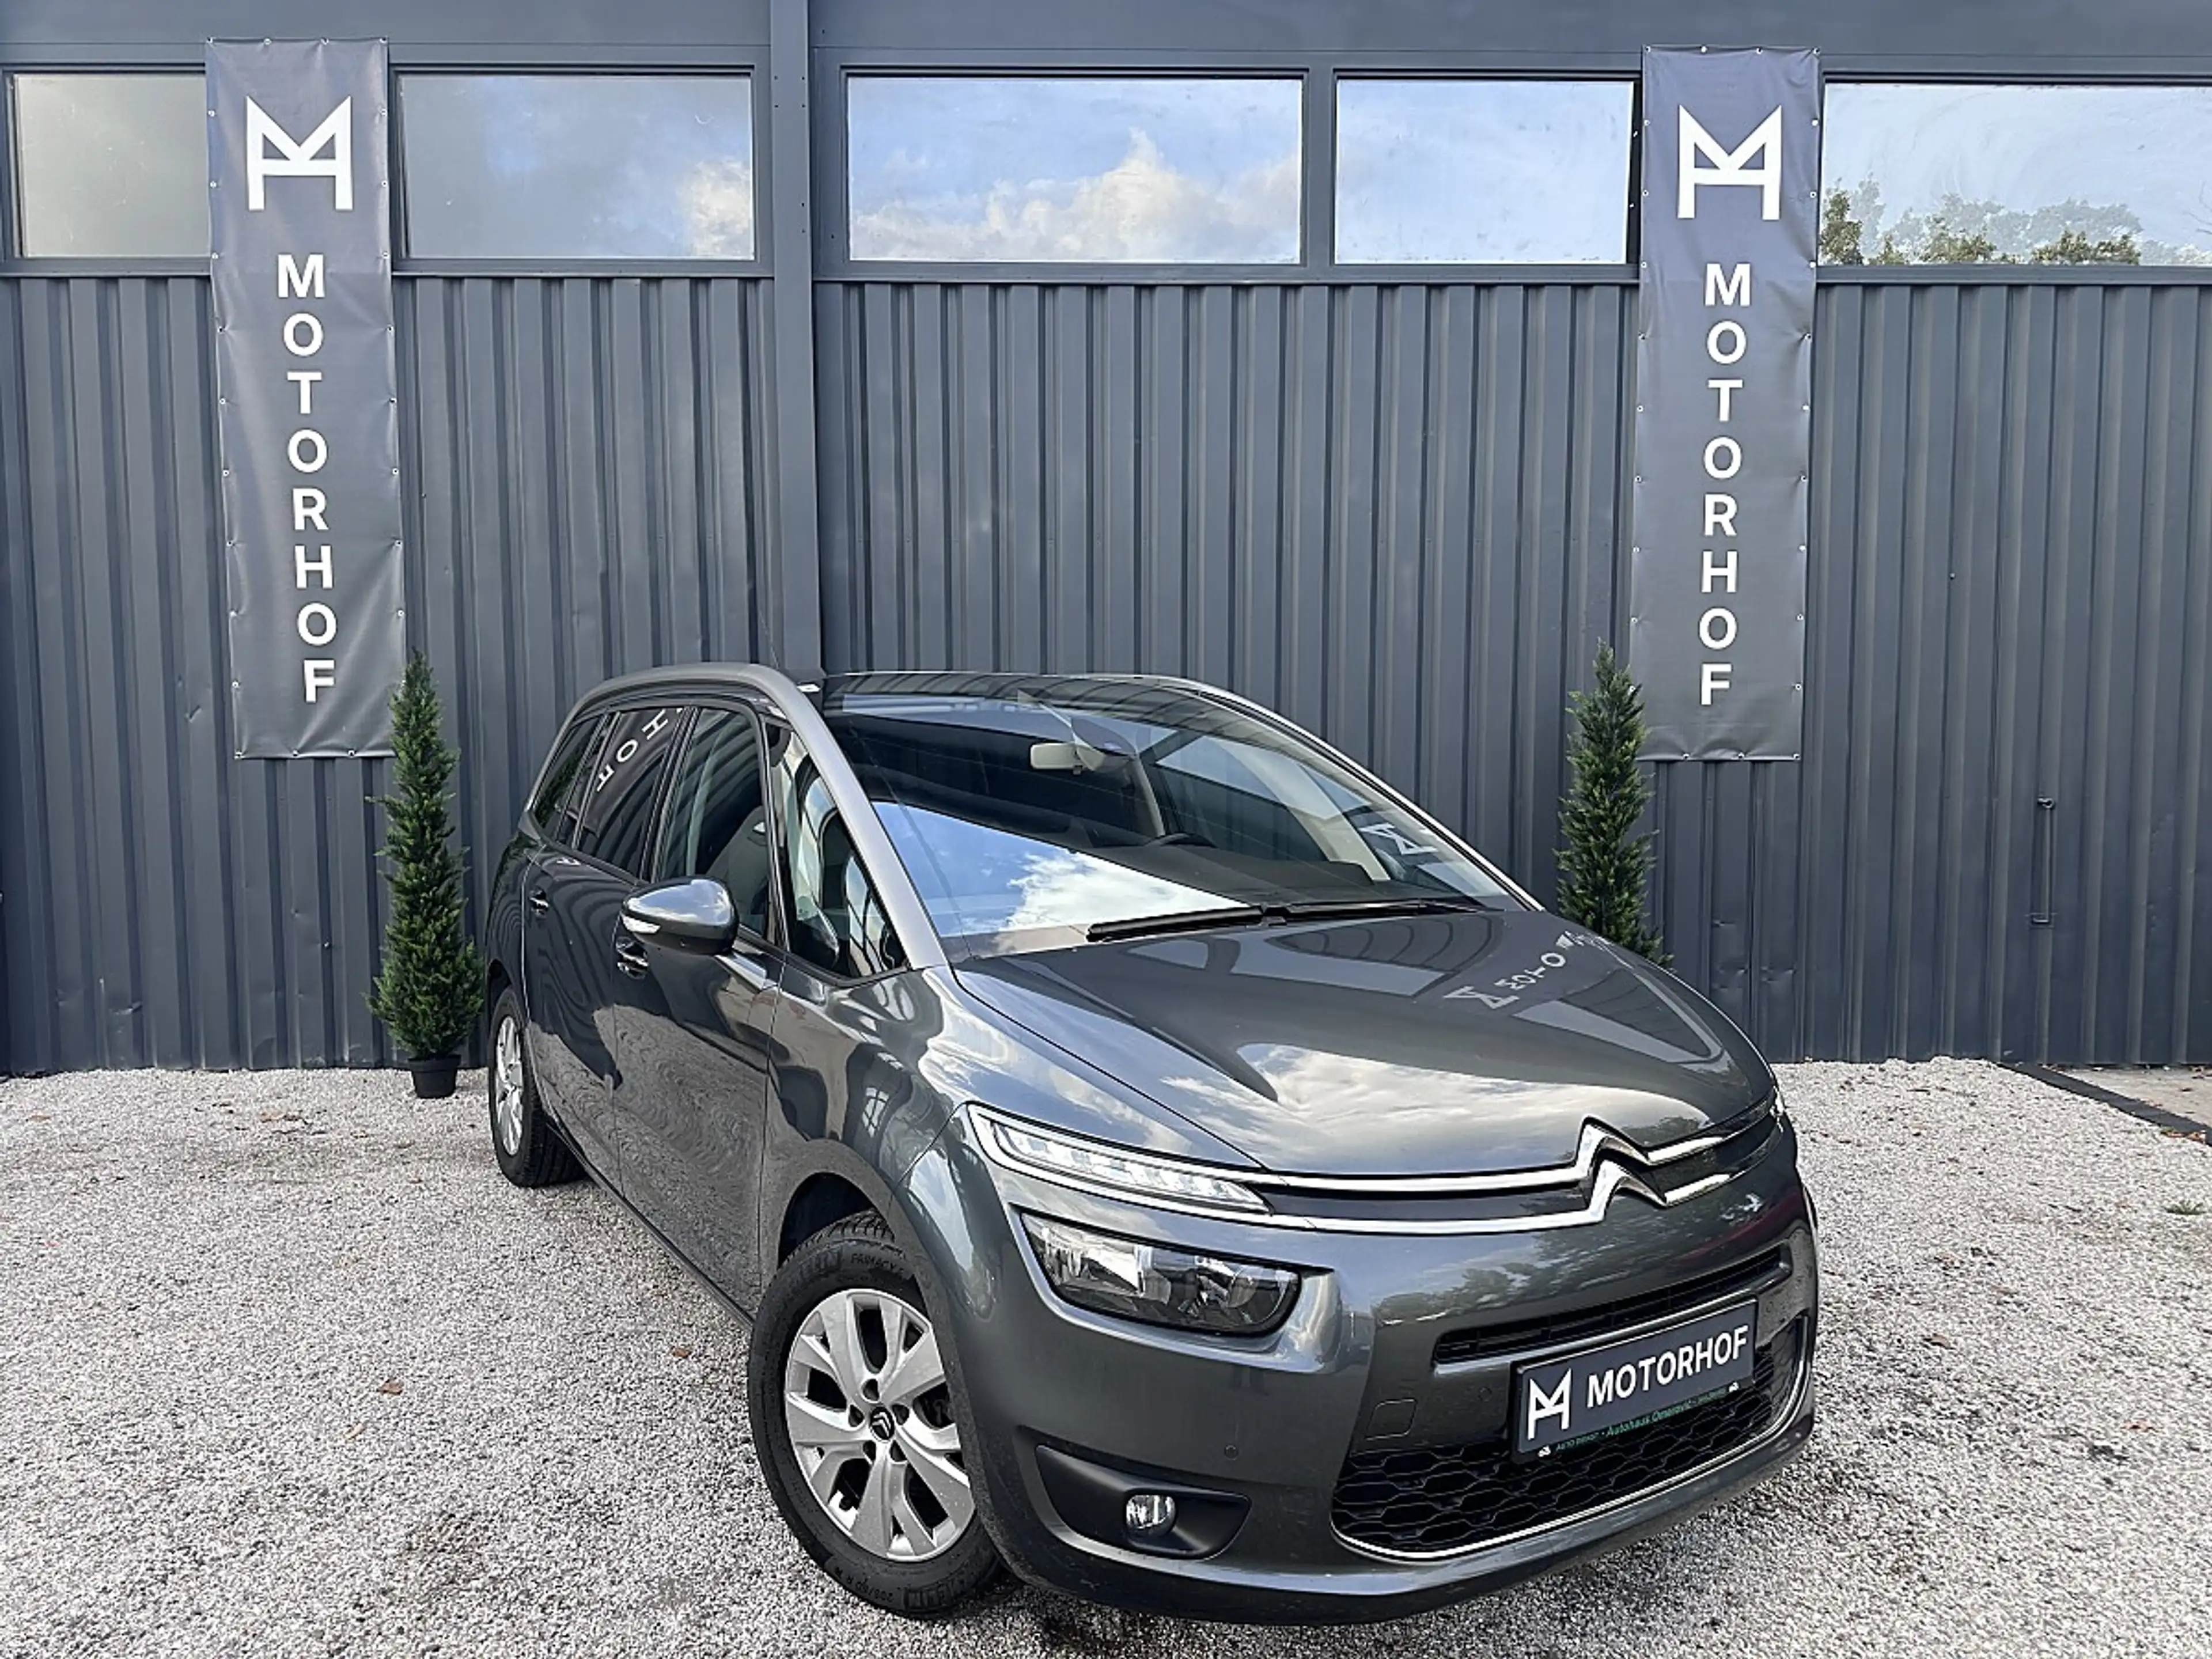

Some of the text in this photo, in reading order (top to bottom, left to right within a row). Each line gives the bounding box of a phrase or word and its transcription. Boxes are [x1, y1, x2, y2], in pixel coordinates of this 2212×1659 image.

[276, 253, 337, 703] MOTORHOF
[1697, 262, 1752, 706] MOTORHOF
[1586, 1325, 1749, 1408] MOTORHOF
